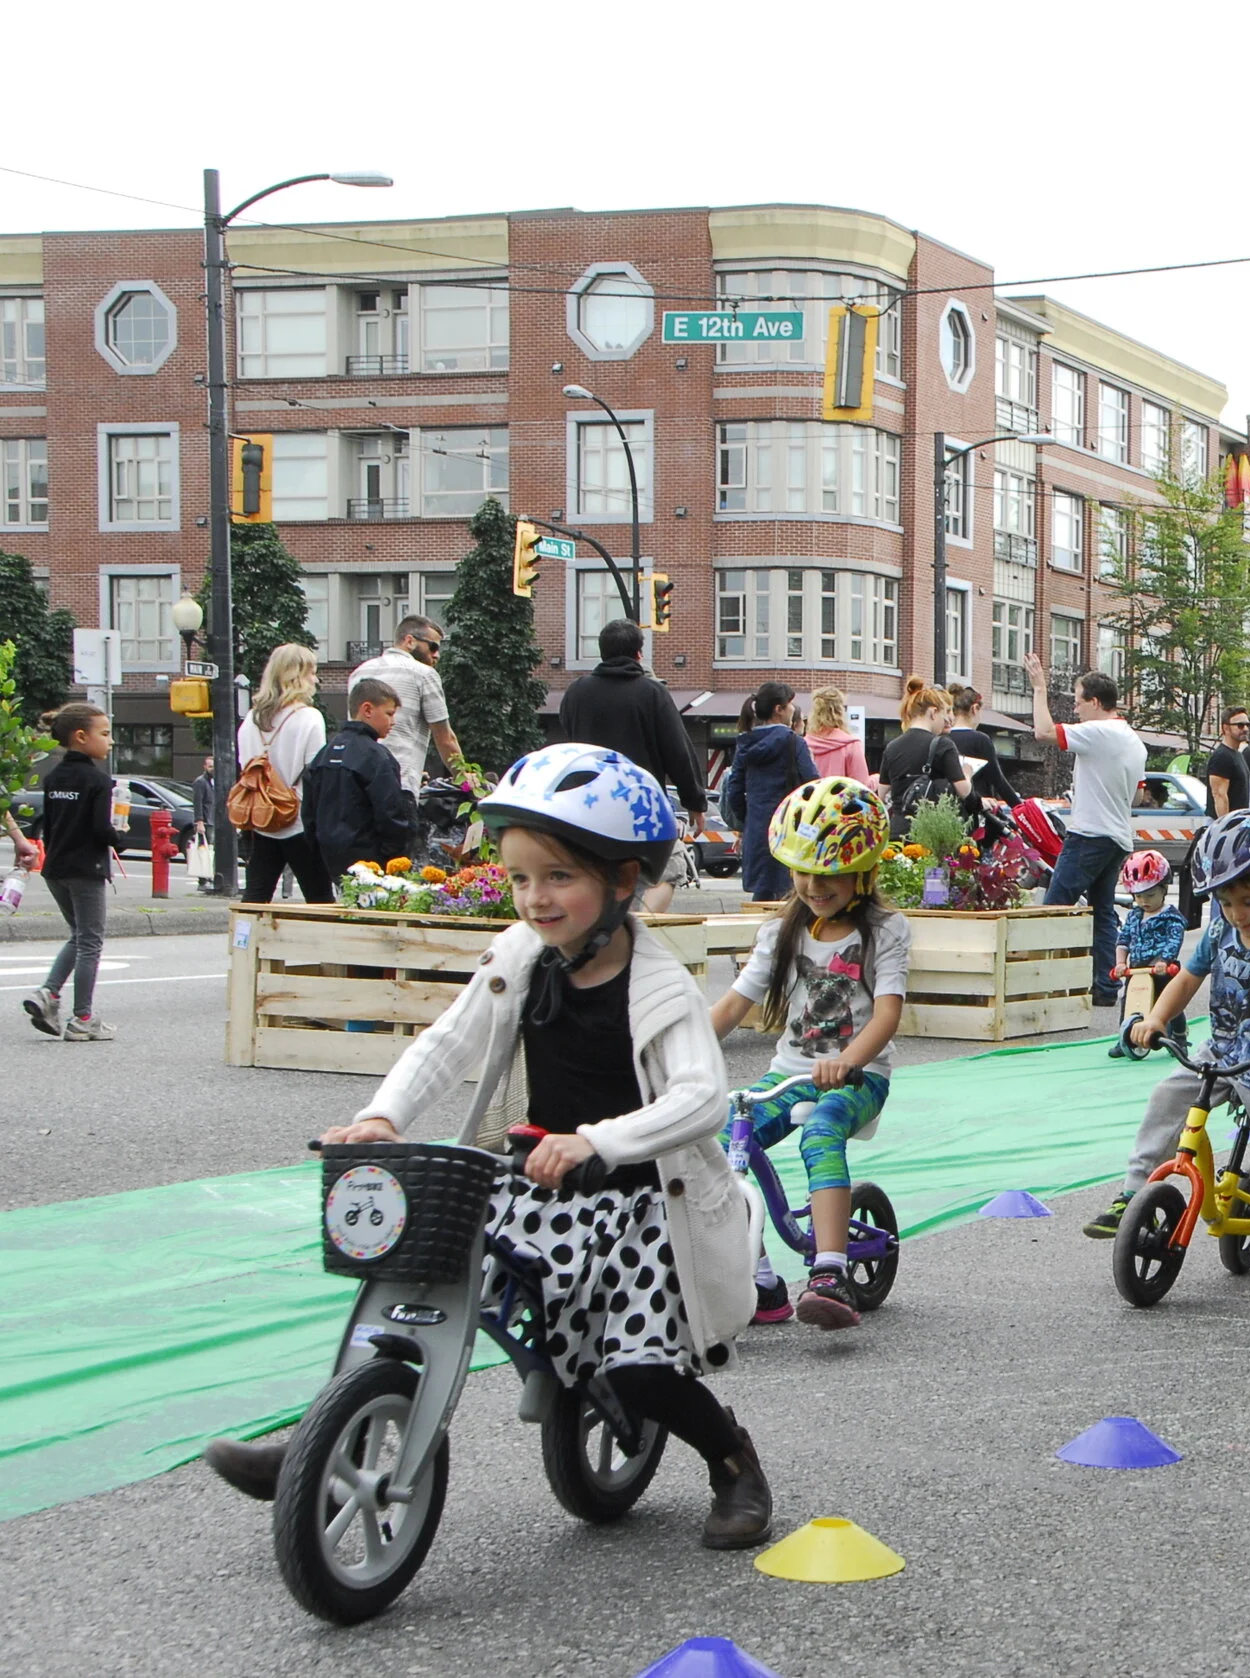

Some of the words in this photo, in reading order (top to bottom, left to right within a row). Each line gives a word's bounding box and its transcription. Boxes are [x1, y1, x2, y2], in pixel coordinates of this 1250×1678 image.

[673, 317, 689, 337] E
[698, 316, 744, 337] 12th
[752, 316, 793, 337] Ave
[538, 540, 559, 555] Main
[560, 542, 571, 557] St
